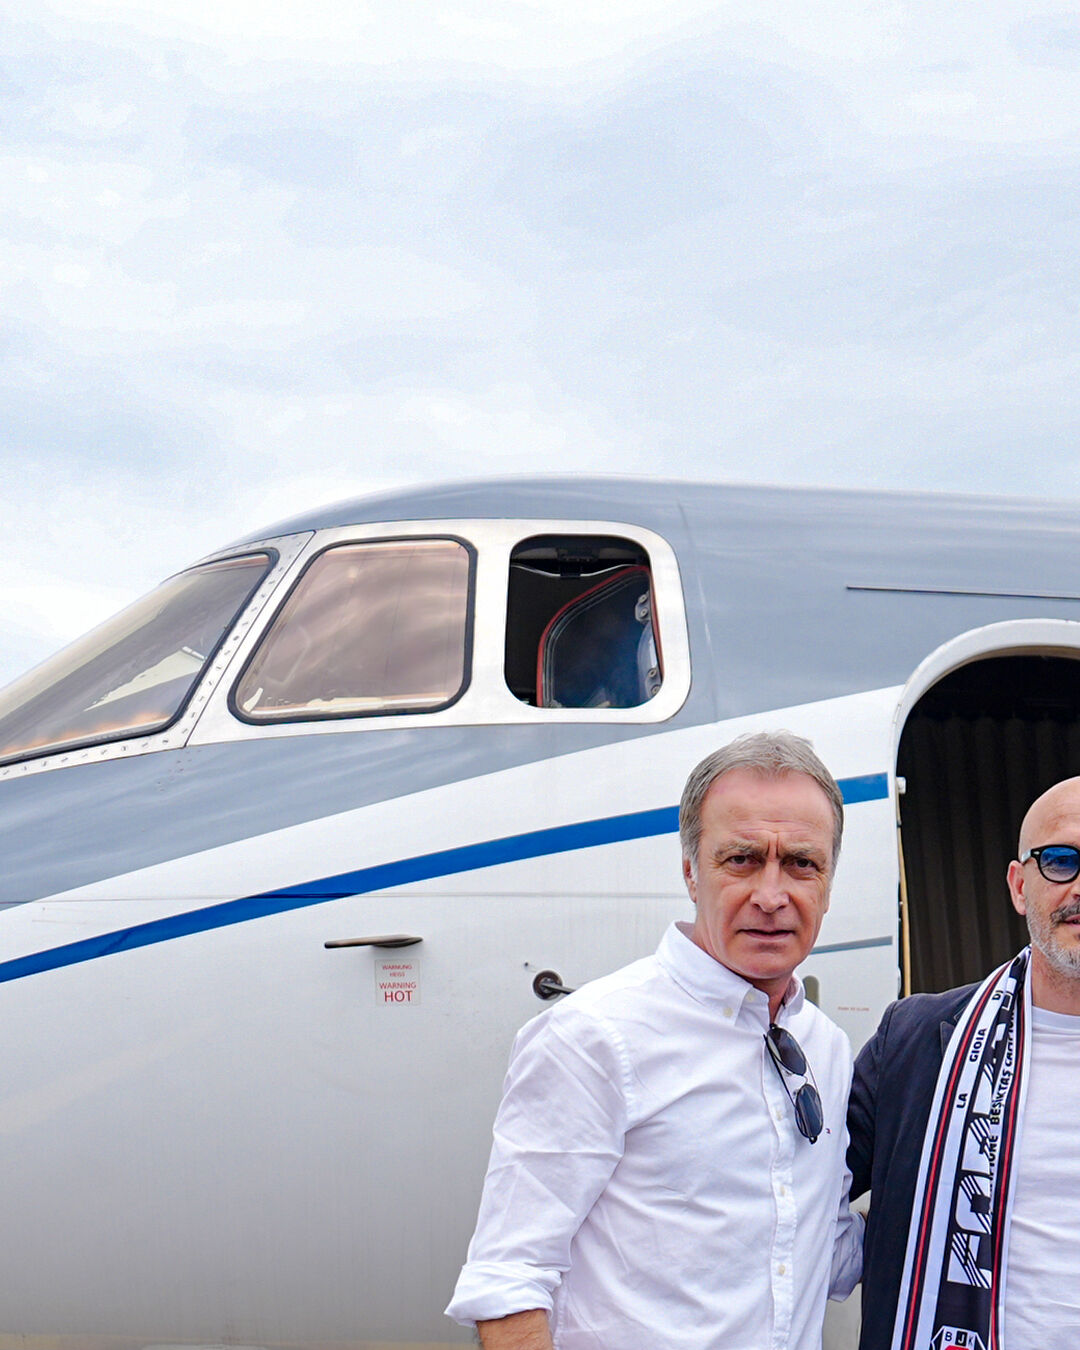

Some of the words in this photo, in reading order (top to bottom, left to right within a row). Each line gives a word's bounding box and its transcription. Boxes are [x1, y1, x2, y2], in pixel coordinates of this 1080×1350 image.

[379, 981, 417, 989] WARNING
[384, 990, 413, 1002] HOT
[956, 1093, 968, 1109] LA
[969, 1028, 987, 1062] GIOIA
